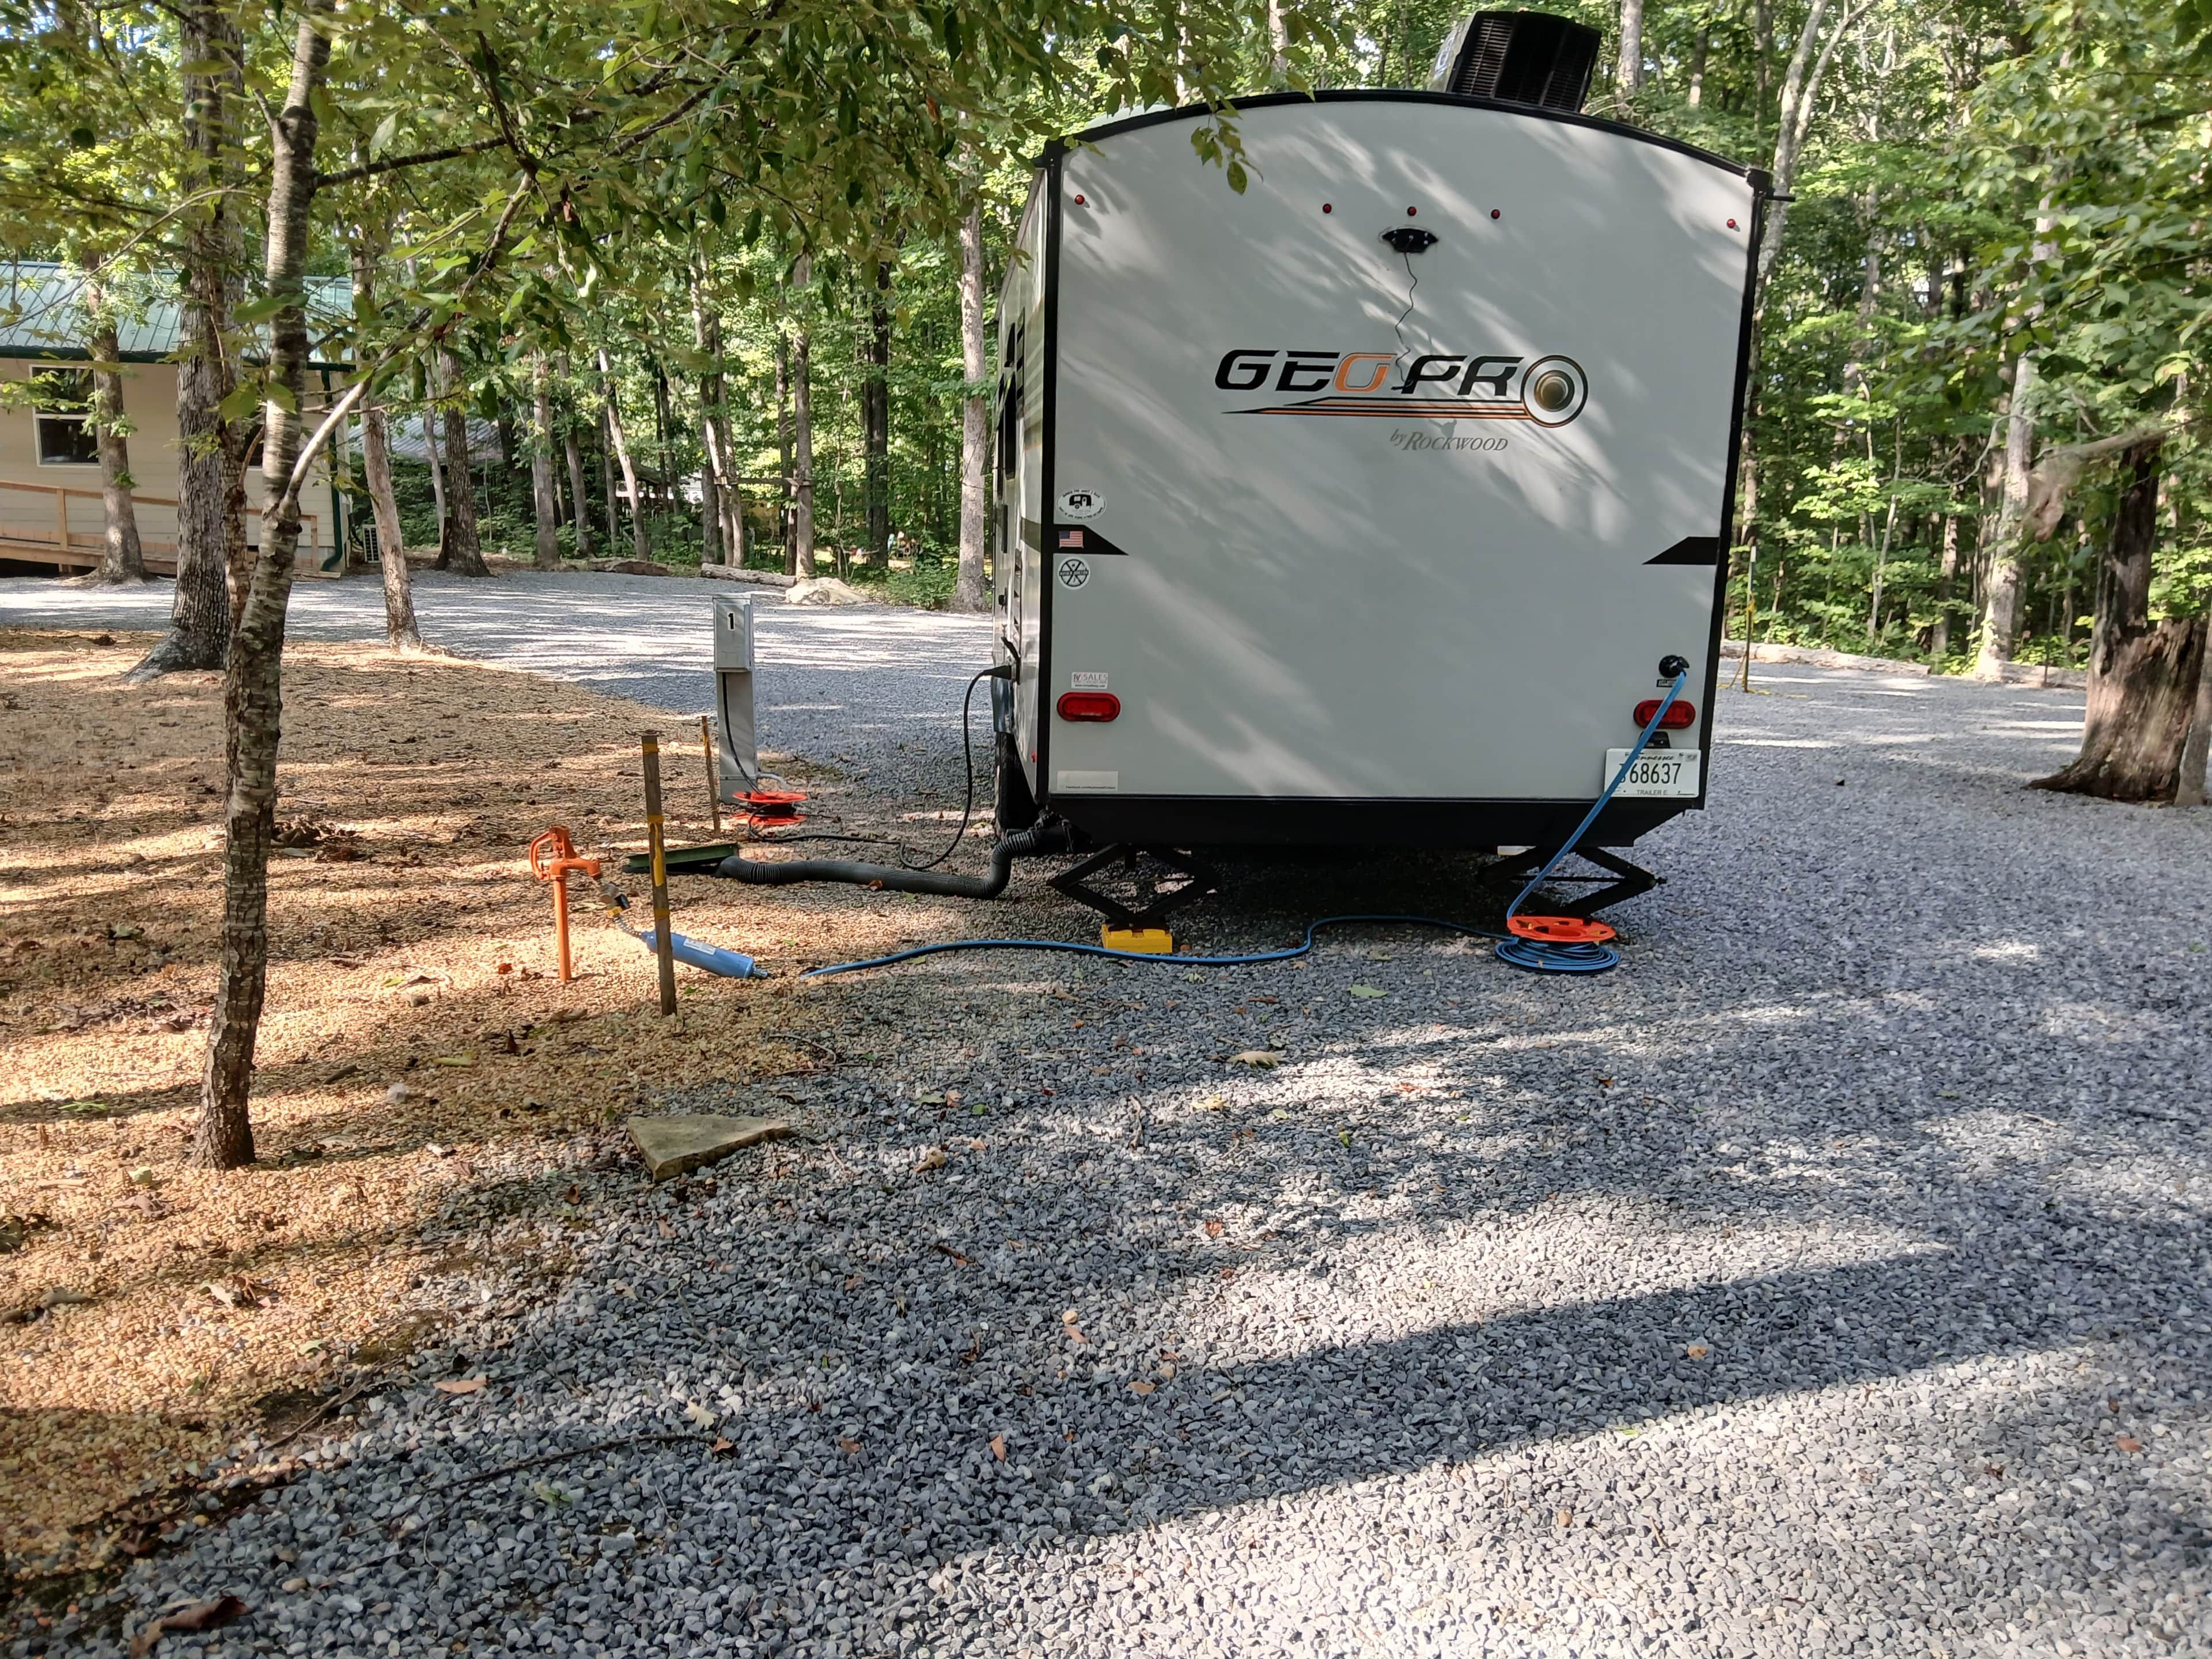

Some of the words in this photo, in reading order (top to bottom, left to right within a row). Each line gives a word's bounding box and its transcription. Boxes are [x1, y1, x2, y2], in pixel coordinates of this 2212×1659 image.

[1215, 349, 1398, 392] GEO
[1389, 429, 1407, 446] by
[728, 613, 734, 630] 1
